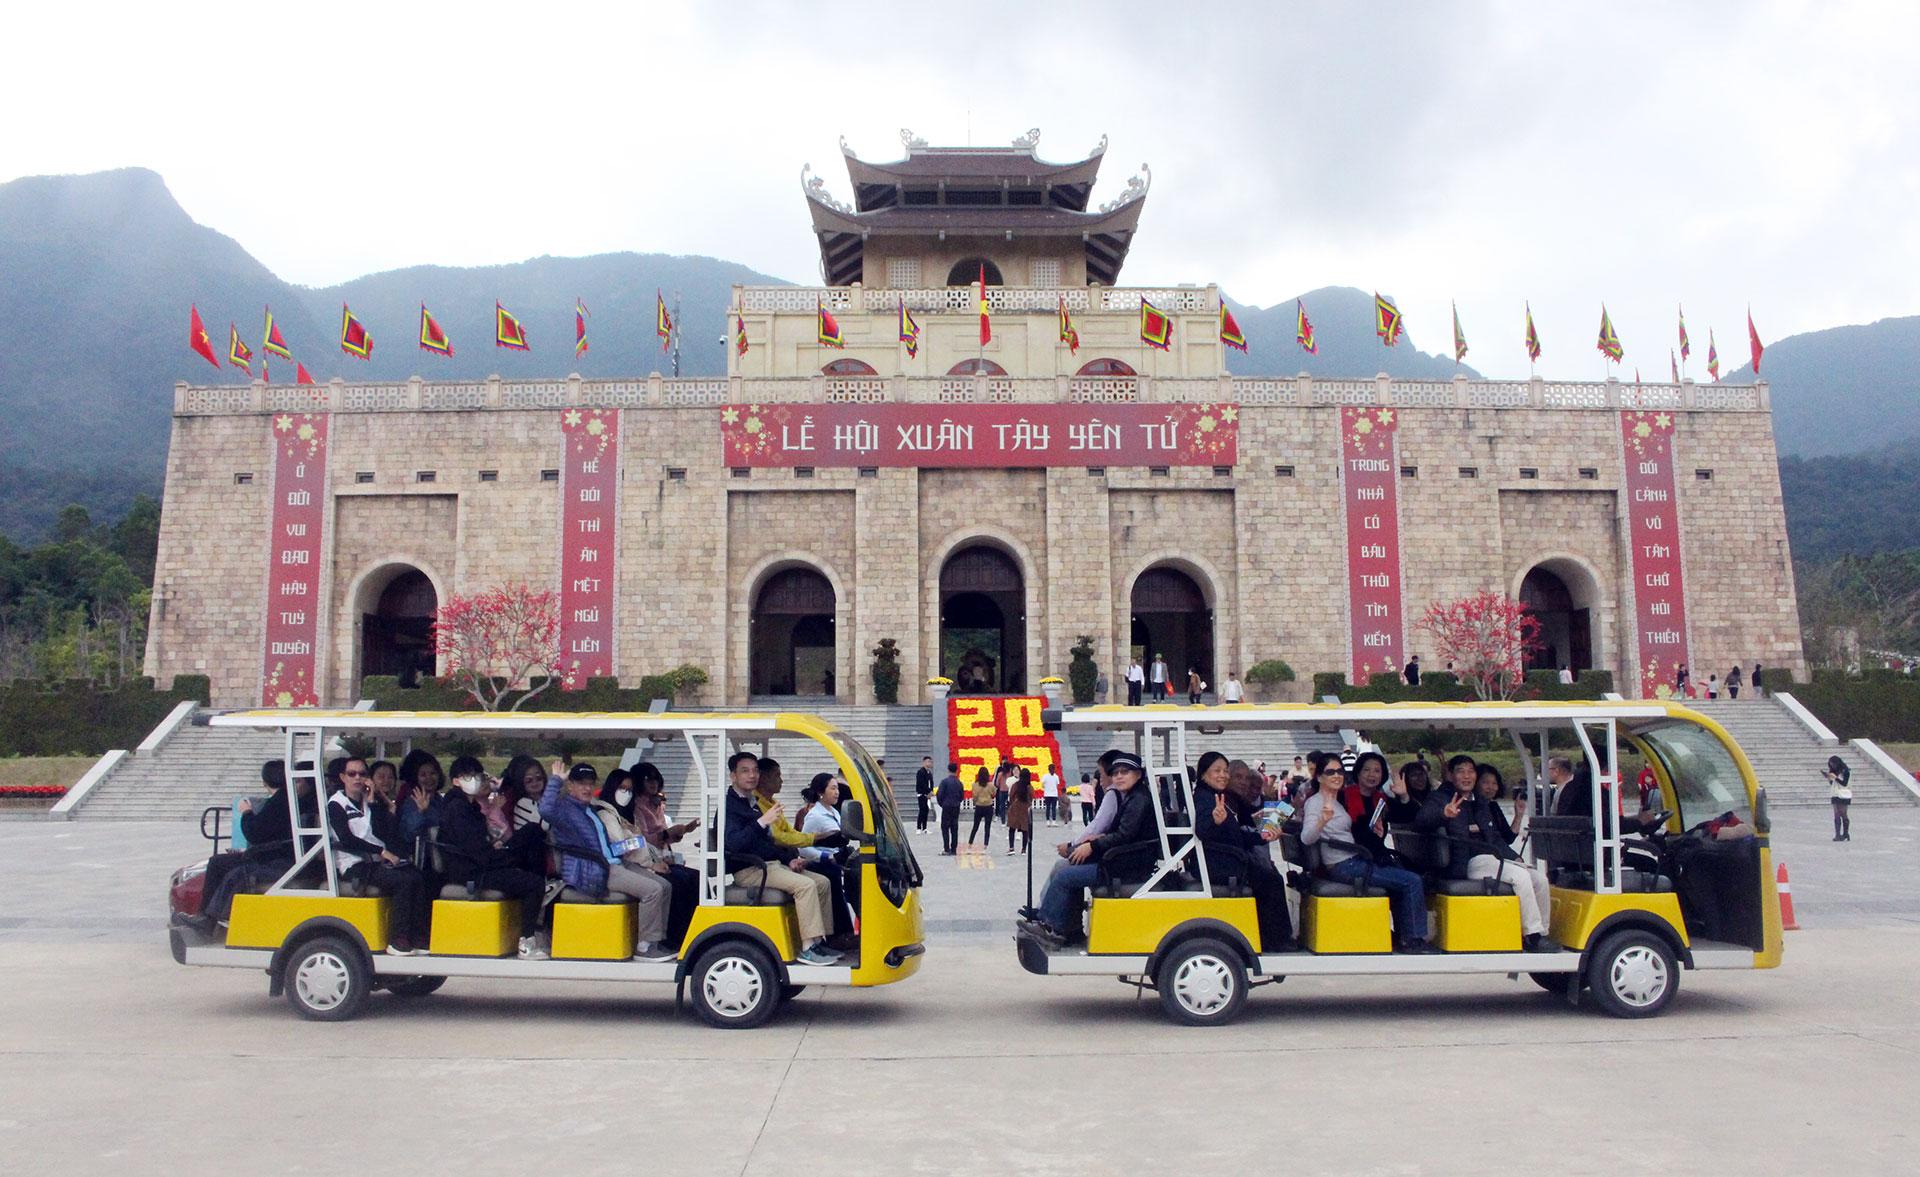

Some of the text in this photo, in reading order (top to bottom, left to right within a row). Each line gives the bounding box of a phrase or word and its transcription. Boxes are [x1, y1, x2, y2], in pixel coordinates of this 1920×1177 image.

[783, 415, 1179, 455] LỄ HỘI XUÂN TÂY YÊN TỬ
[579, 486, 600, 502] ĐÓI
[1635, 486, 1667, 502] CẢNH
[286, 523, 307, 536] VUI
[1645, 515, 1662, 529] VÔ
[281, 550, 309, 567] ĐẠO
[1350, 458, 1391, 646] TRONG NHÀ CÓ BÁU THÔI TÌM KIẾM
[1643, 543, 1670, 558] TÂM
[573, 576, 601, 594] MỆT
[574, 605, 599, 622] NGỦ
[1651, 599, 1670, 615] HỎI
[271, 639, 310, 655] DUYÊN
[956, 698, 1045, 737] 20
